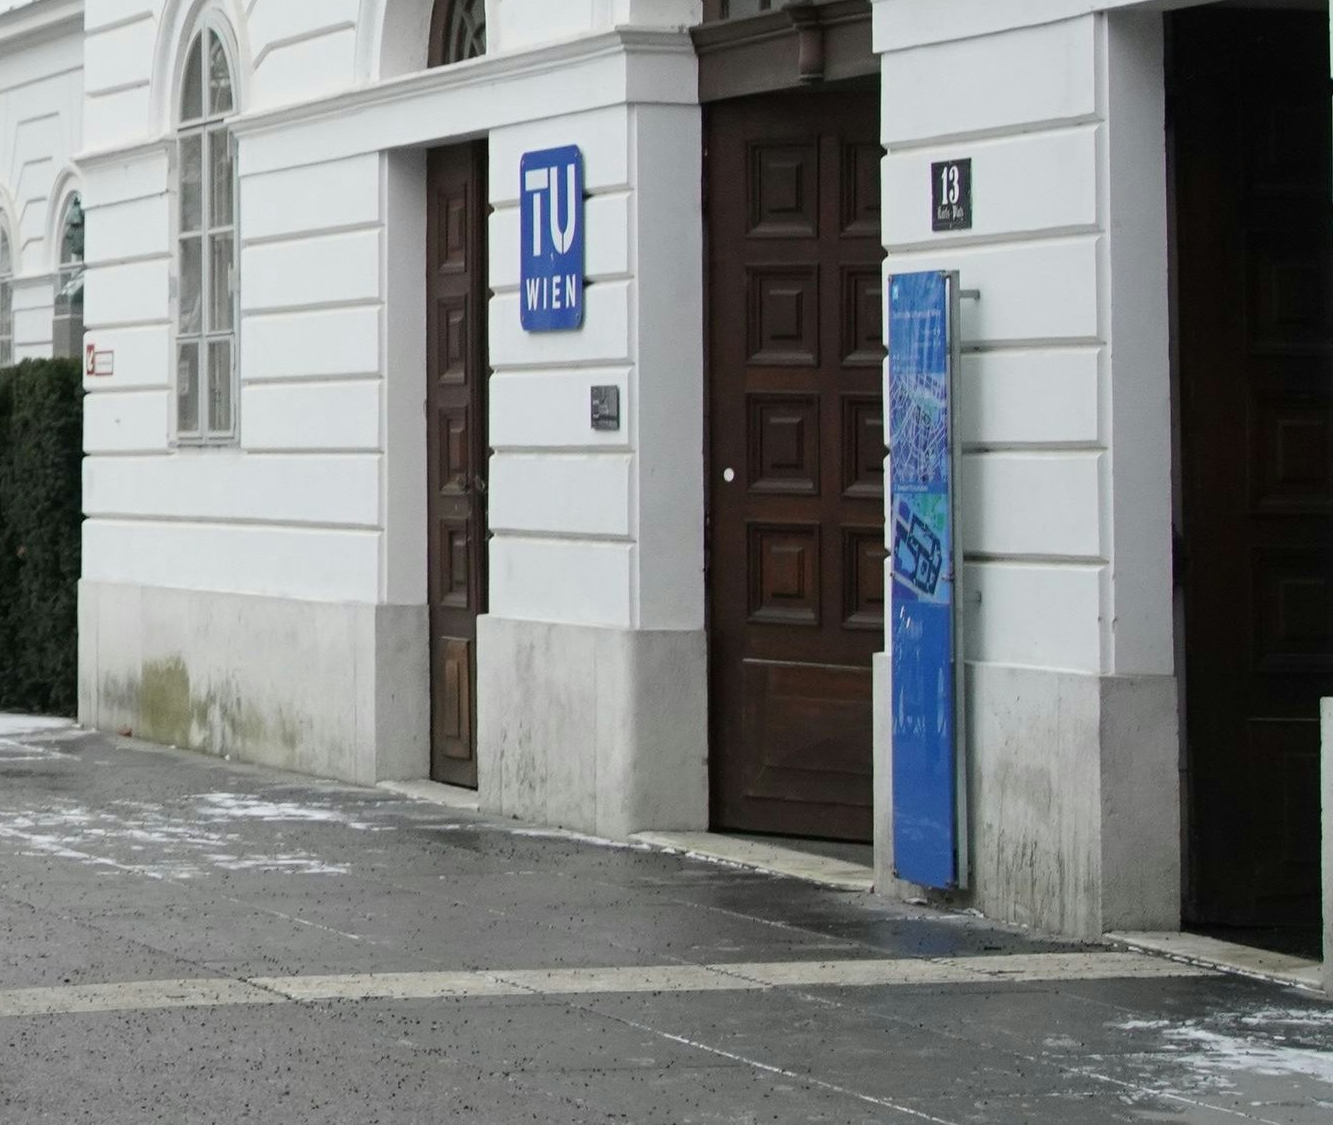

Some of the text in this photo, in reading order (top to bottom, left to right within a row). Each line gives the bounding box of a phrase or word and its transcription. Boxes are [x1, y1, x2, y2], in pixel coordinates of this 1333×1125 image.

[941, 165, 960, 205] 13
[525, 163, 576, 257] TU
[526, 274, 576, 311] WIEN
